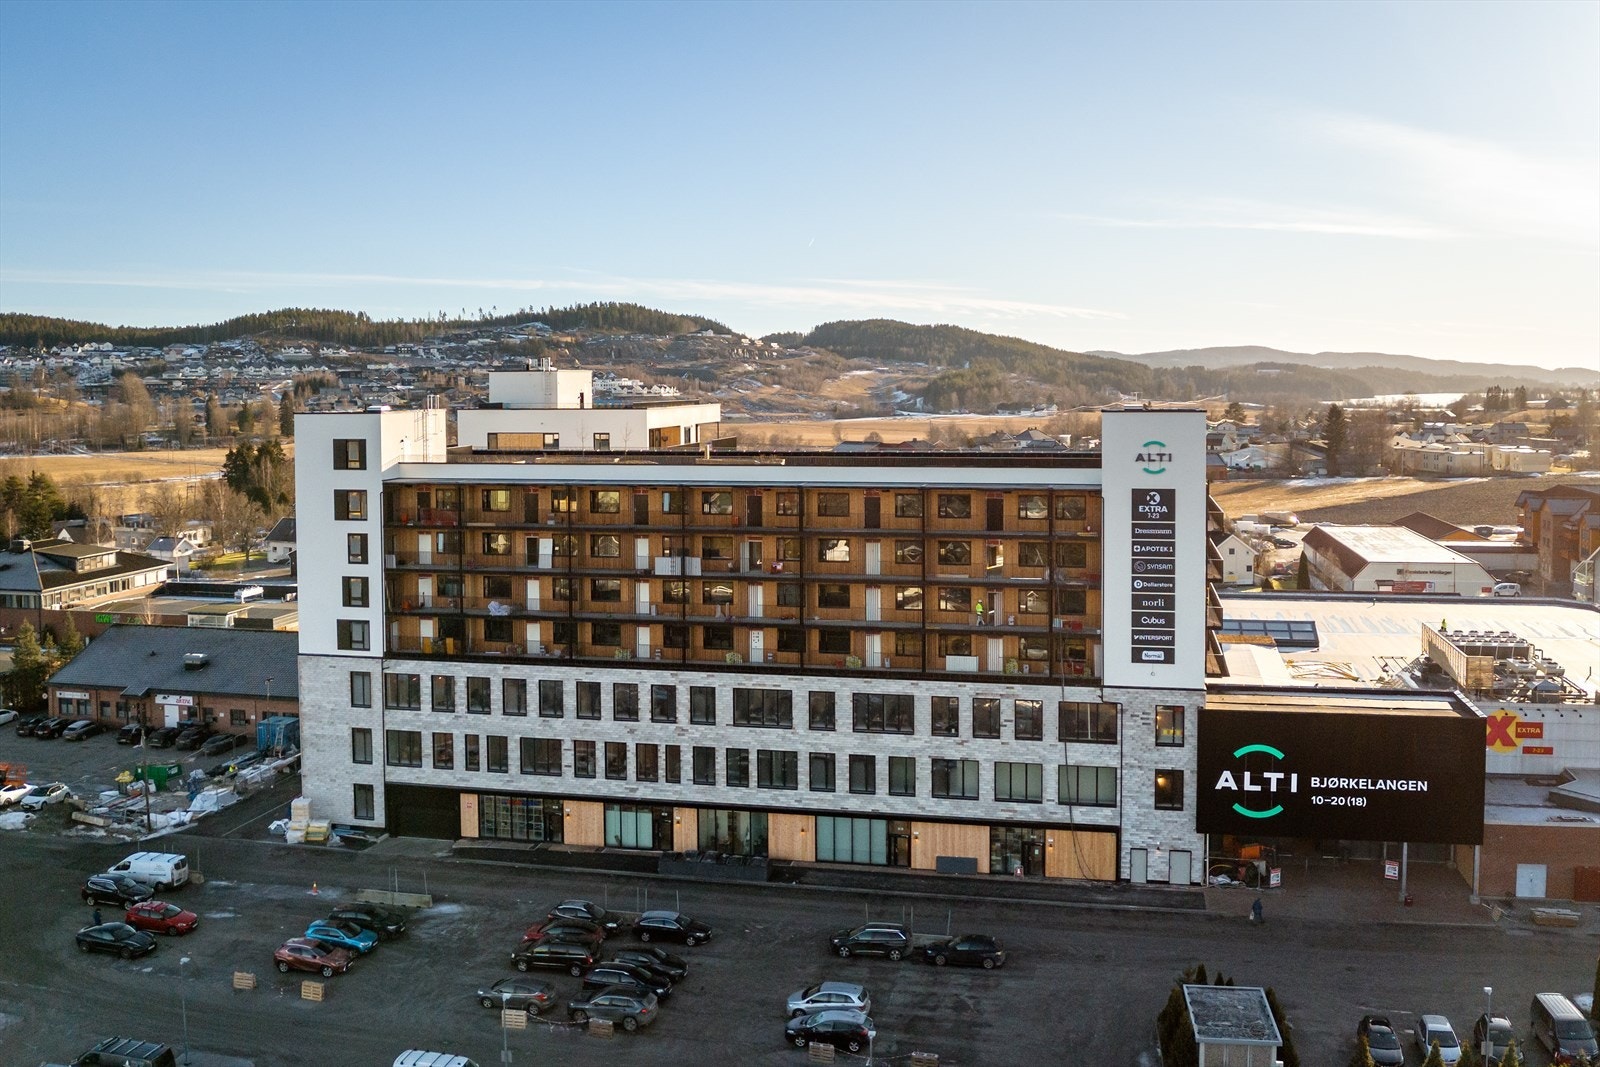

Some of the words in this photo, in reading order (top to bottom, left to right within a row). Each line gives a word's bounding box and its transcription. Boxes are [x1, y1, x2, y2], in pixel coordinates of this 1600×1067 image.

[1135, 453, 1172, 462] ALTI
[1138, 505, 1168, 513] EXTRA
[1142, 598, 1165, 607] norli
[1141, 616, 1166, 624] Cubus
[1214, 770, 1298, 793] ALTI
[1310, 776, 1428, 792] BJØRKELANGEN
[1347, 796, 1368, 808] (18)
